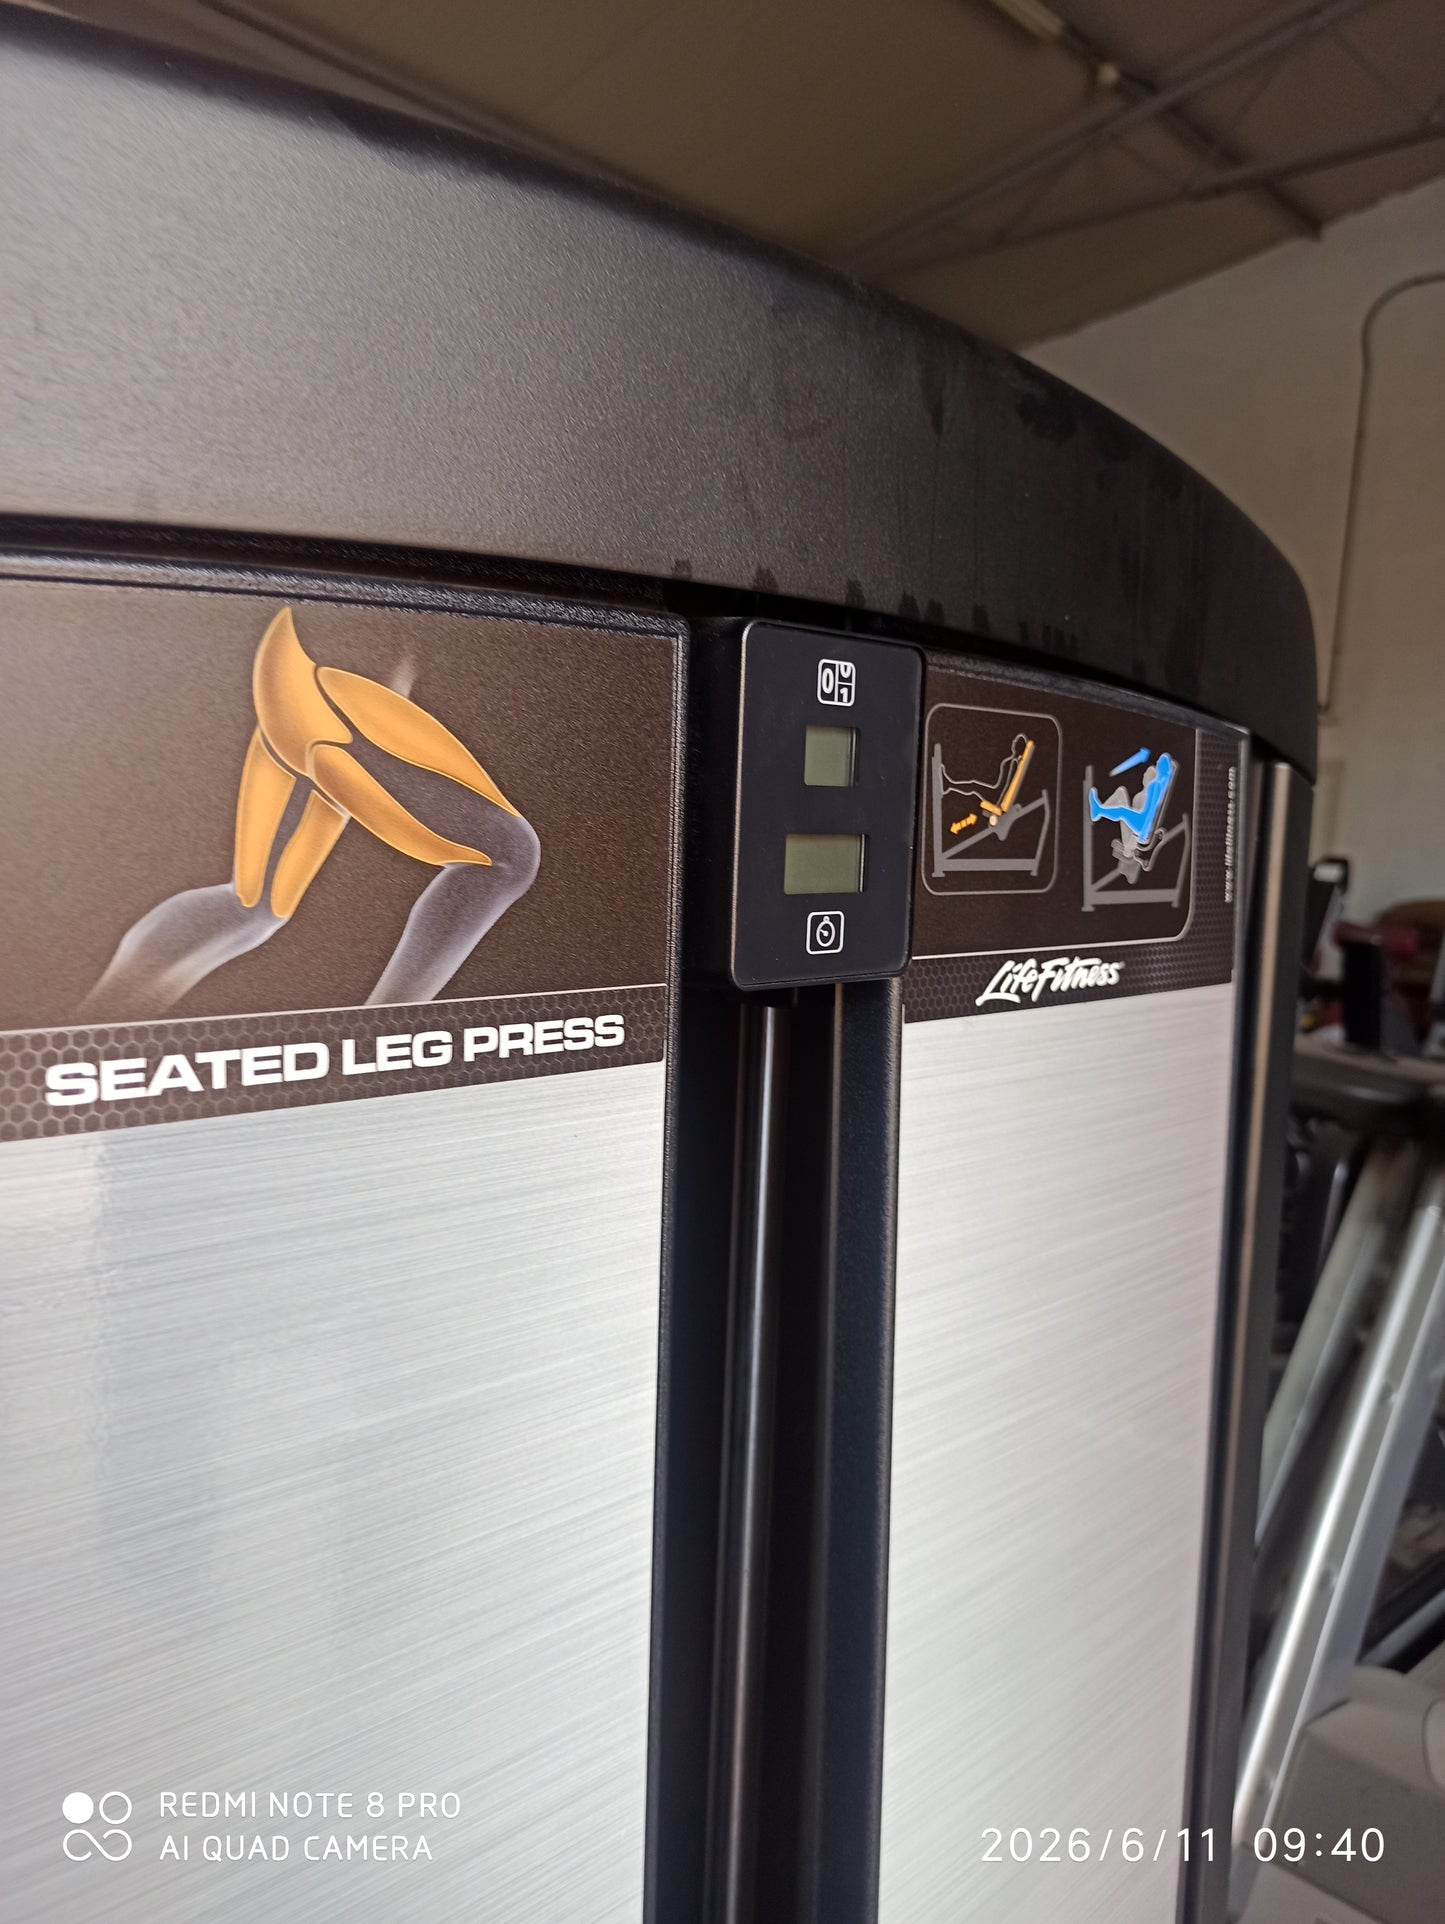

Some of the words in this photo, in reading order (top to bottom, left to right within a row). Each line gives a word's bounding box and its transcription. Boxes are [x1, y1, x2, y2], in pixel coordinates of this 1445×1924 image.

[45, 1041, 330, 1107] SEATED
[341, 1030, 453, 1076] LEG
[463, 1014, 625, 1062] PRESS
